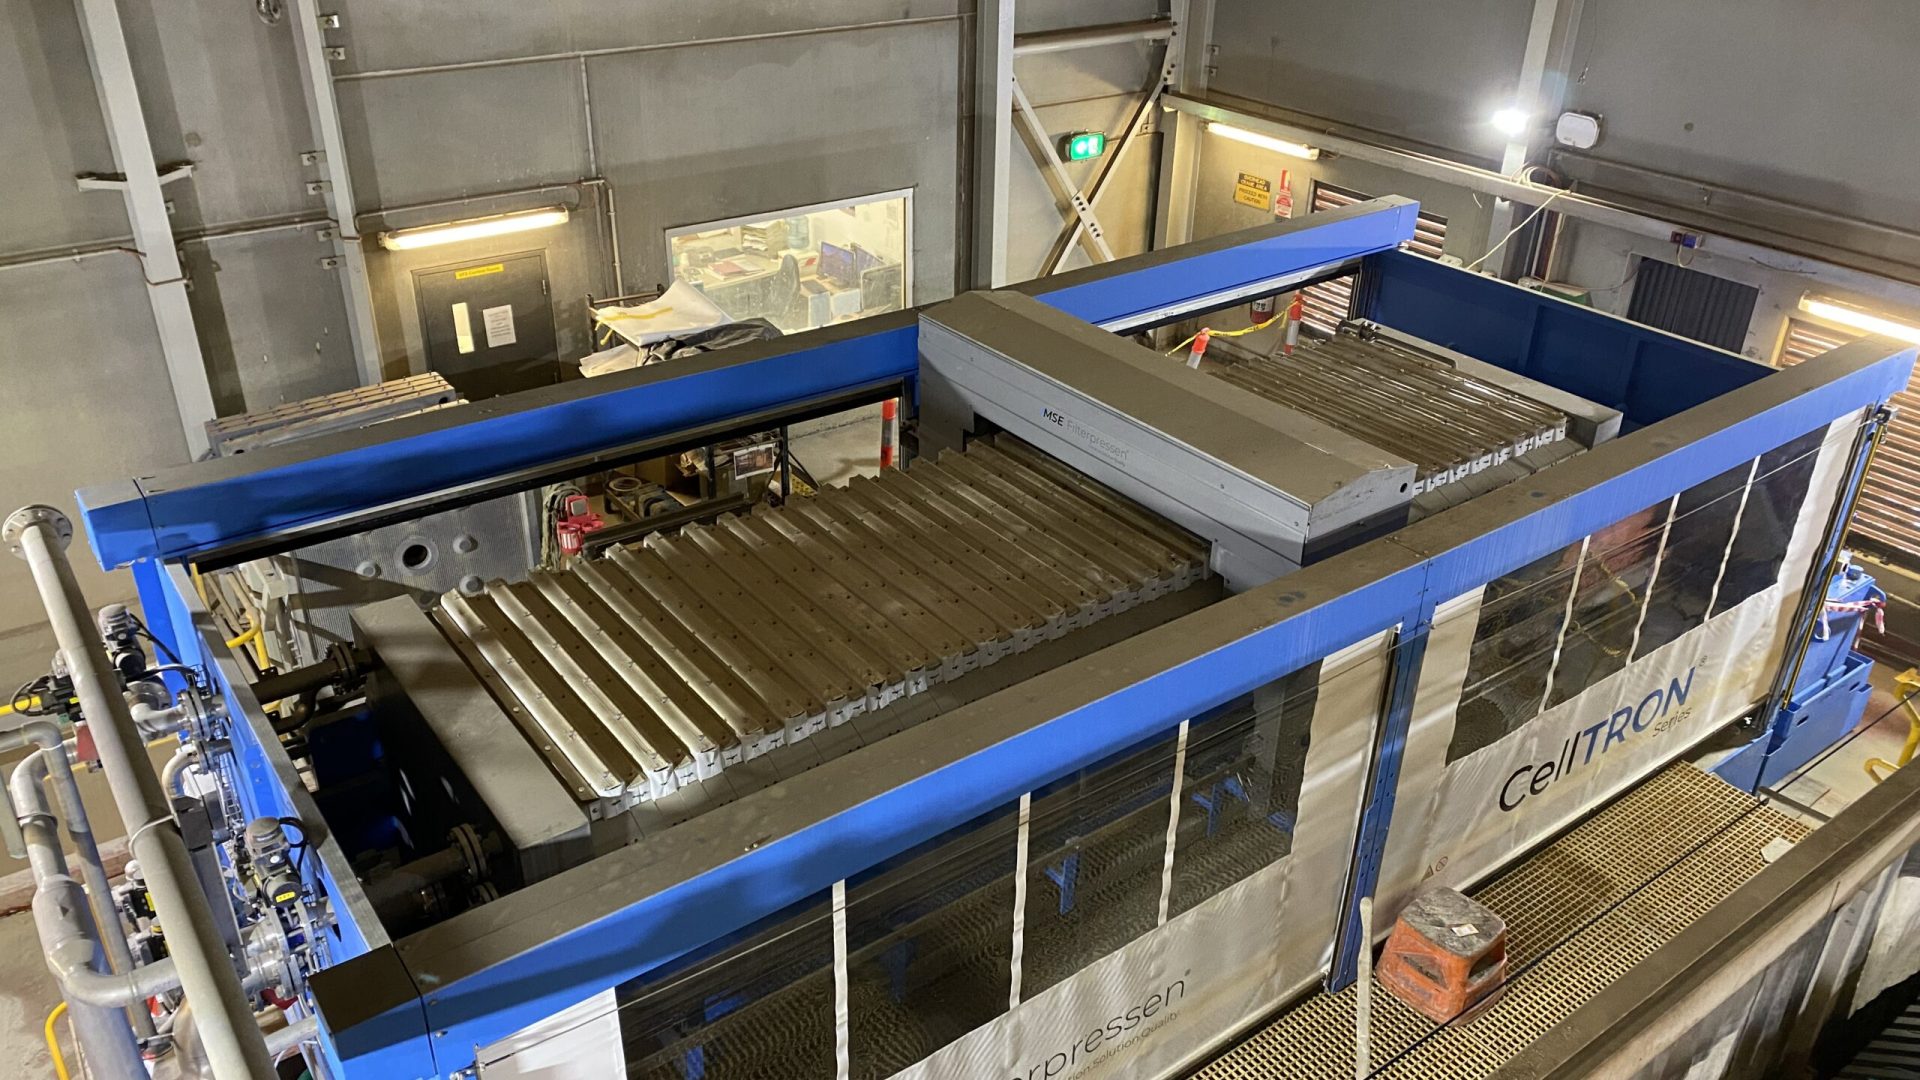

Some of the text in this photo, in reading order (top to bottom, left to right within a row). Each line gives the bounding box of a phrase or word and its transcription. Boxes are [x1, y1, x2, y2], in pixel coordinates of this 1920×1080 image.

[1043, 408, 1064, 427] MSE
[1066, 420, 1127, 460] Filterpressen
[1499, 666, 1695, 812] CellTRON
[1652, 707, 1692, 738] Series
[1012, 979, 1185, 1080] rpressen
